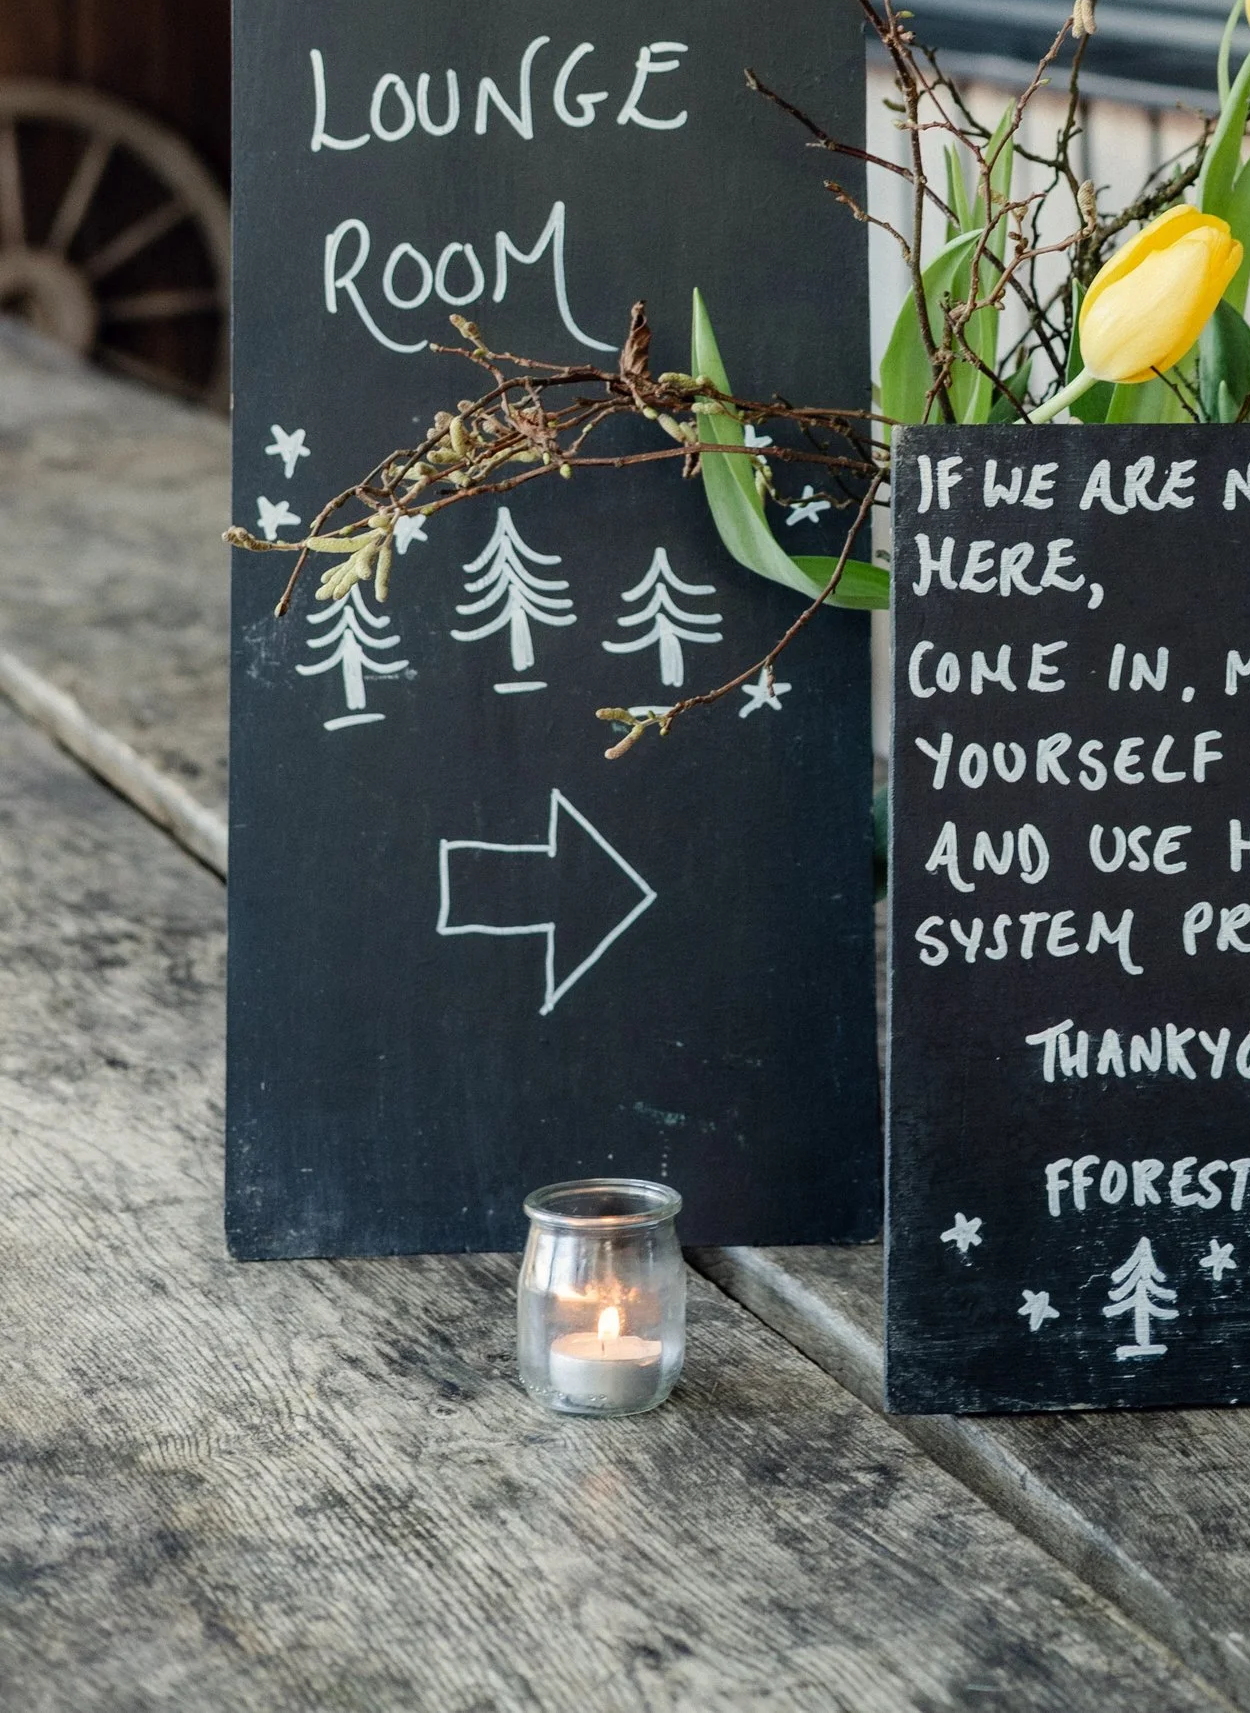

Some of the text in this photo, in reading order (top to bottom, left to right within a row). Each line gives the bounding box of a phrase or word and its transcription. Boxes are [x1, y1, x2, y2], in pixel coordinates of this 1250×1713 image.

[309, 35, 689, 153] LOUNGE
[324, 200, 621, 354] ROOM
[916, 454, 964, 514] IF
[982, 458, 1060, 510] WE
[1078, 455, 1198, 515] ARE
[912, 532, 1104, 610] HERE,
[908, 640, 1068, 699] COME
[914, 730, 1224, 792] YOURSELF
[924, 820, 1050, 893] AND
[1089, 823, 1192, 875] USE
[914, 908, 1144, 976] SYSTEM
